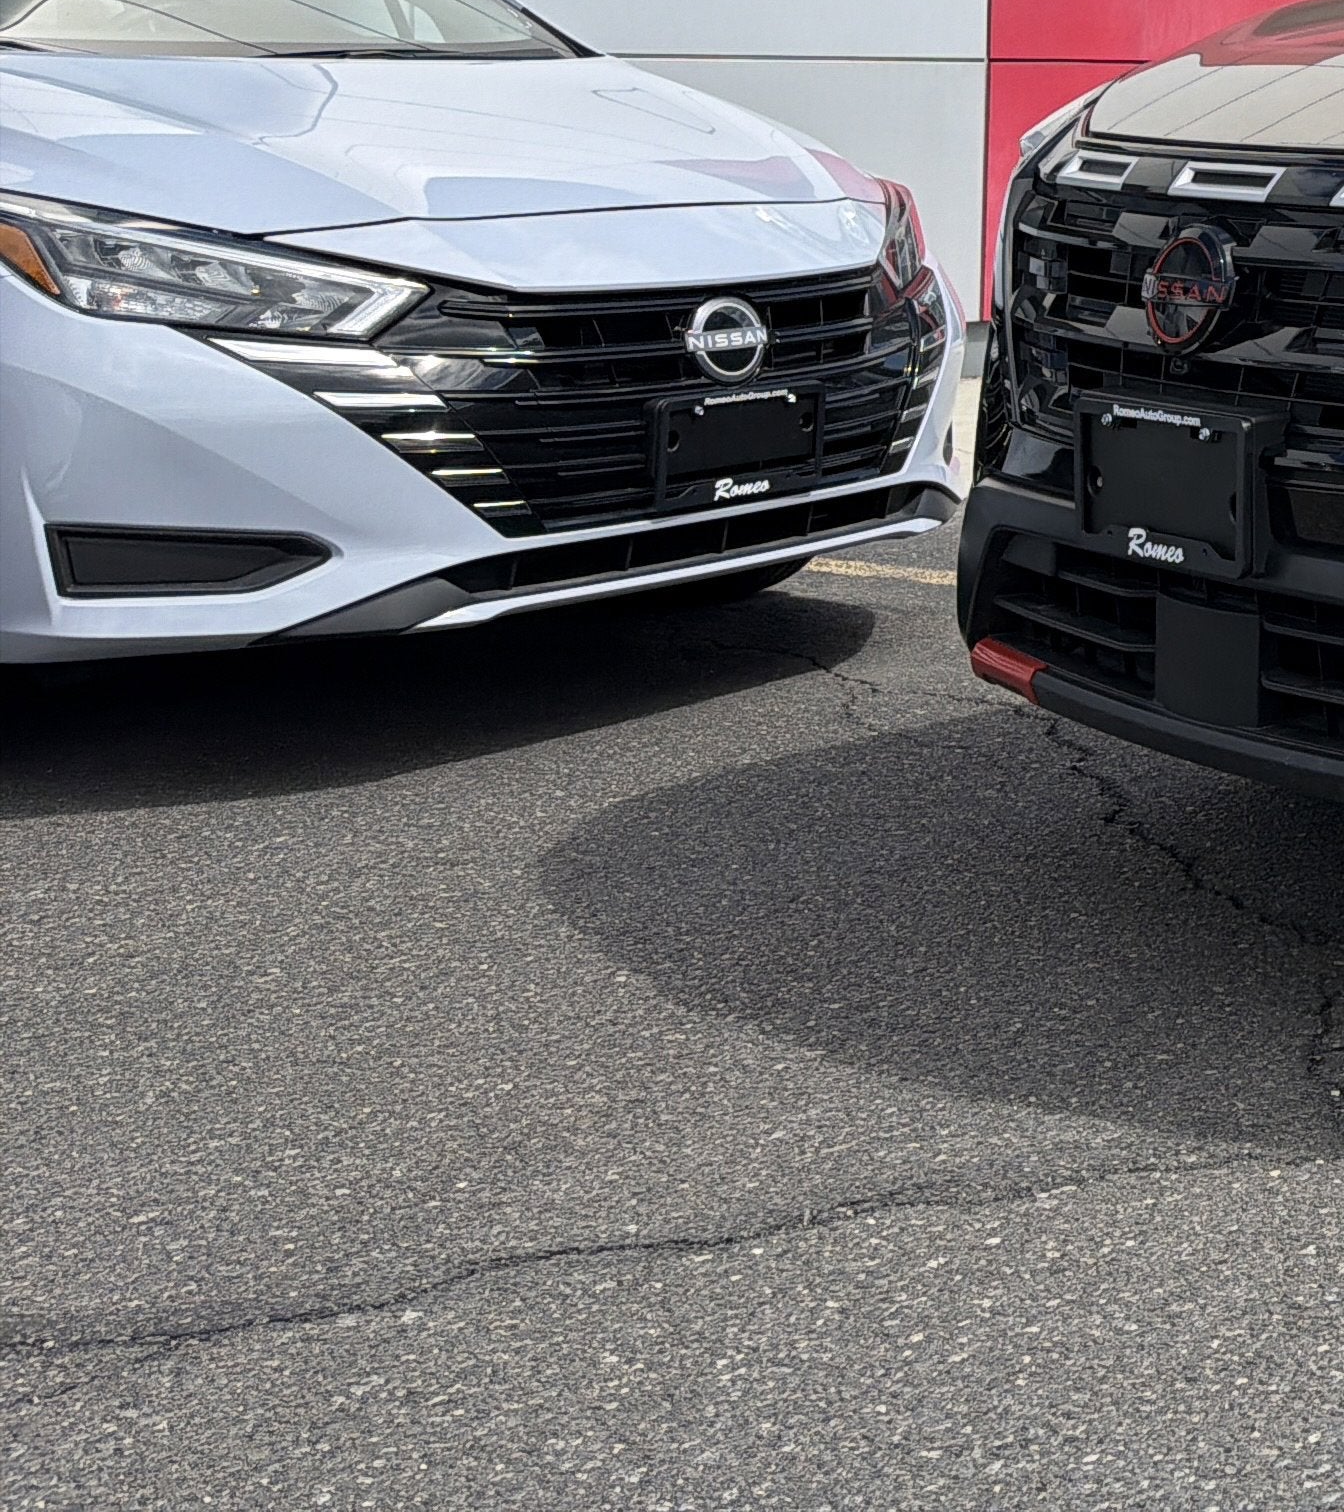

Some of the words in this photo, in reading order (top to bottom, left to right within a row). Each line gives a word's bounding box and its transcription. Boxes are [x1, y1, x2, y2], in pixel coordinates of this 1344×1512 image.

[1142, 274, 1229, 304] NISSAN
[687, 327, 768, 350] NISSAN
[704, 388, 789, 407] RomeoAutoGroup.com
[1113, 403, 1201, 427] RomeoAutoGroup.com
[713, 477, 770, 502] Romeo
[1127, 527, 1185, 563] Romeo
